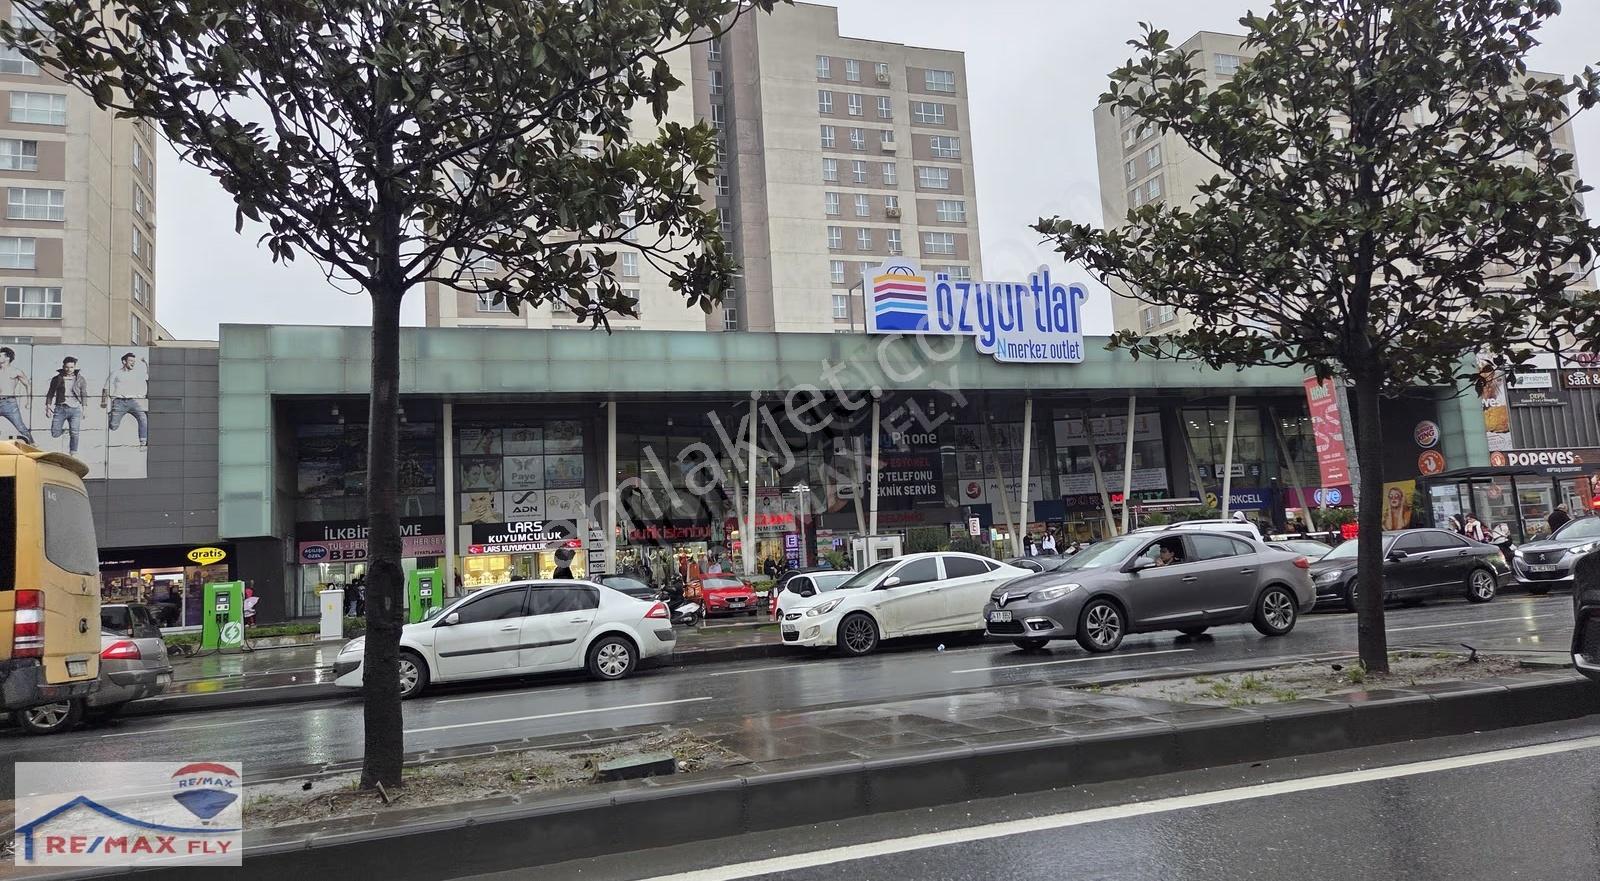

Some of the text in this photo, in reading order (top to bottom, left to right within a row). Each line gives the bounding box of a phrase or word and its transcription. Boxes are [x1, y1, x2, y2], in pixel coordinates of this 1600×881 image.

[936, 270, 1084, 347] özyurtlar
[1050, 340, 1080, 359] outlet
[1568, 373, 1591, 386] Saat
[886, 470, 933, 481] TELEFONU
[904, 482, 937, 496] SERVİS
[512, 505, 538, 514] ADN
[507, 521, 543, 533] LARS
[663, 524, 711, 539] istanbul
[488, 531, 562, 543] KUYUMCULUK
[483, 543, 547, 553] LARS KUYUMCULUK
[191, 549, 223, 560] gratis
